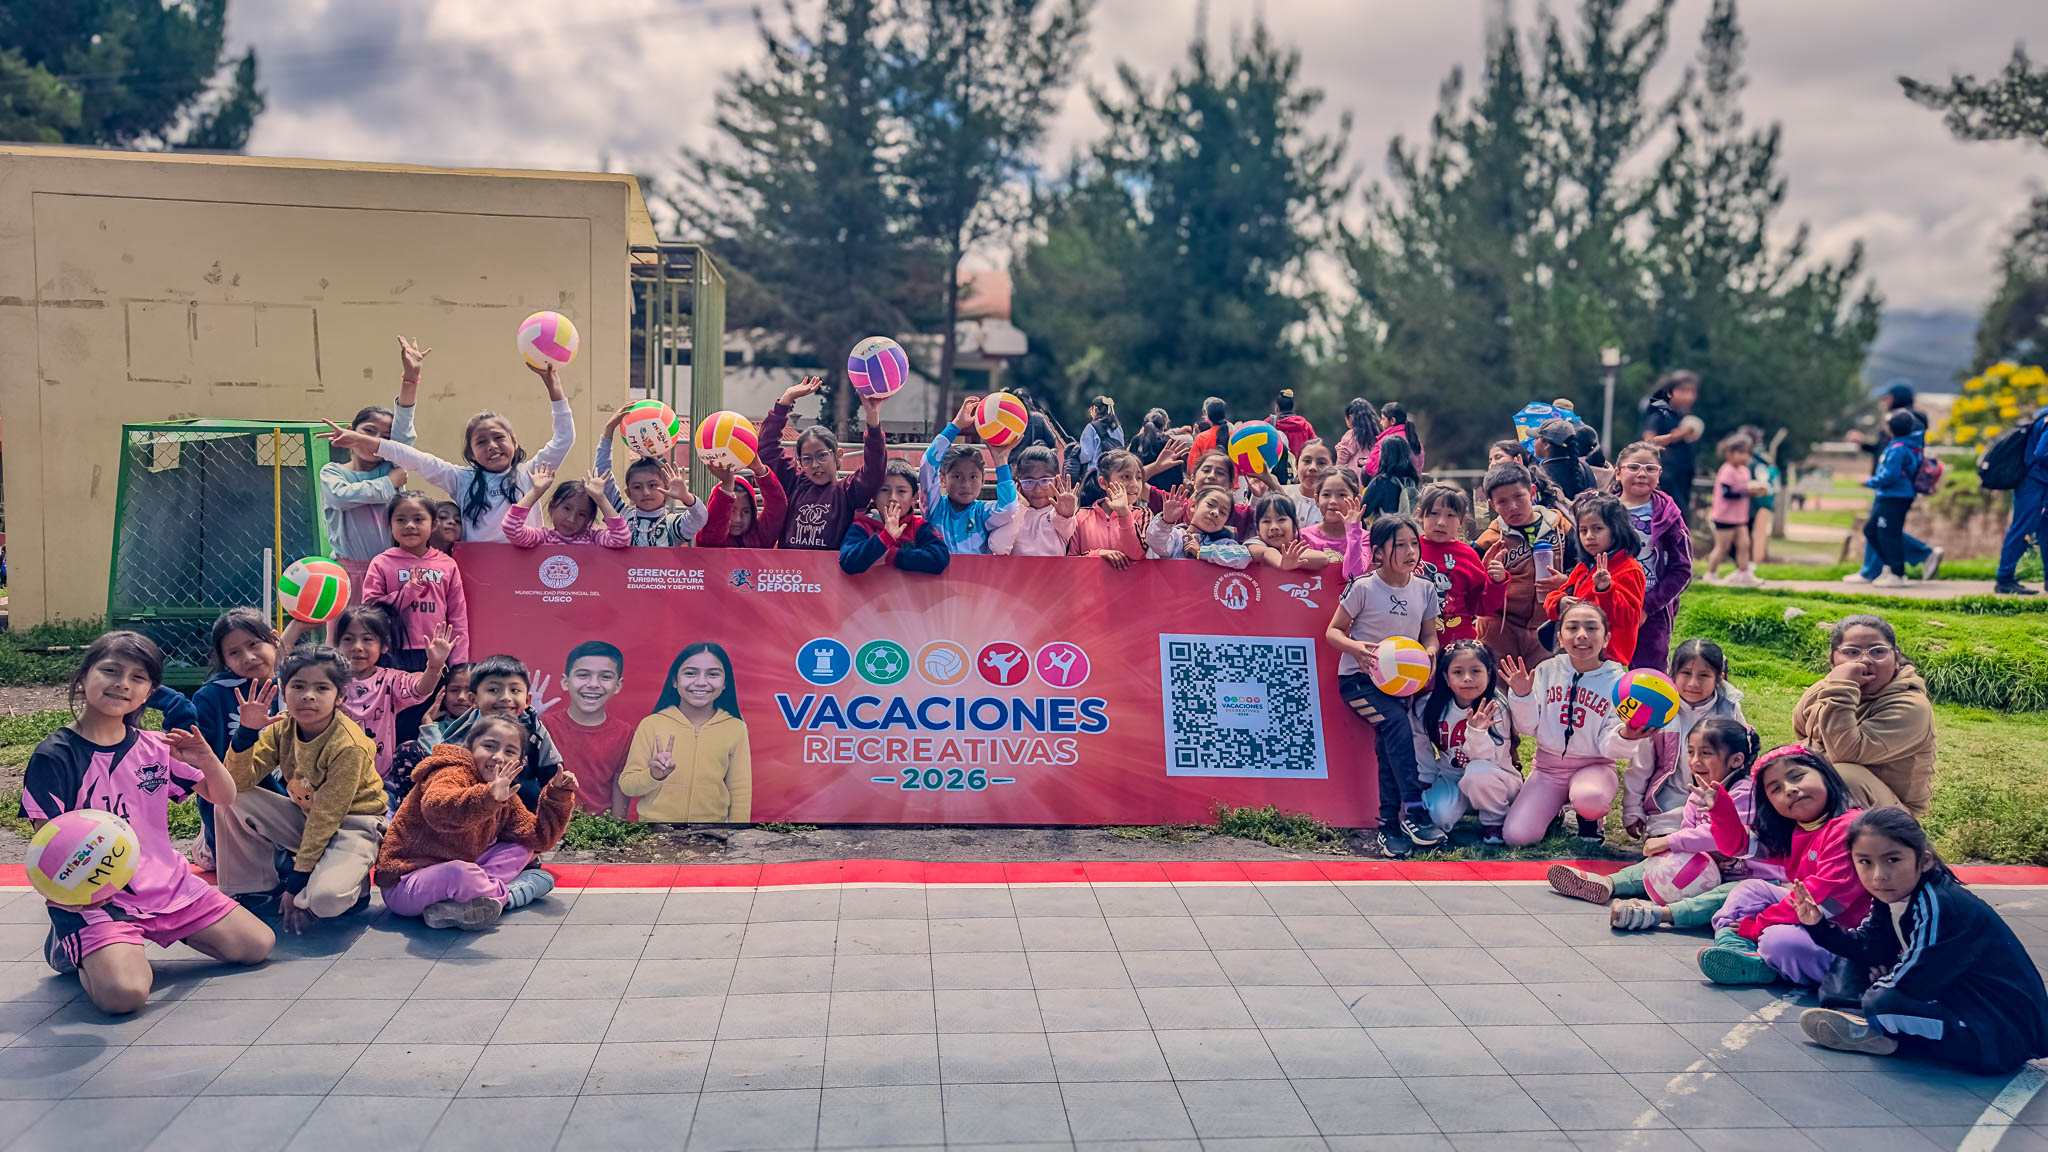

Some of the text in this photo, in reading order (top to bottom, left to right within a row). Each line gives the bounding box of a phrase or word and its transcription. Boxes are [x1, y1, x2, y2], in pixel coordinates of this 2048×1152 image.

[790, 536, 827, 547] CHANEL
[627, 568, 705, 578] GERENCIA DE
[757, 573, 803, 584] CUSCO
[627, 576, 666, 584] TURISMO,
[757, 582, 822, 593] DEPORTES
[542, 595, 573, 603] CUSCO
[1290, 589, 1310, 598] IPD
[410, 600, 436, 613] YOU
[775, 694, 1109, 733] VACACIONES
[1559, 704, 1587, 729] 23
[804, 735, 1079, 765] RECREATIVAS
[900, 767, 988, 791] 2026
[87, 845, 125, 886] MPC
